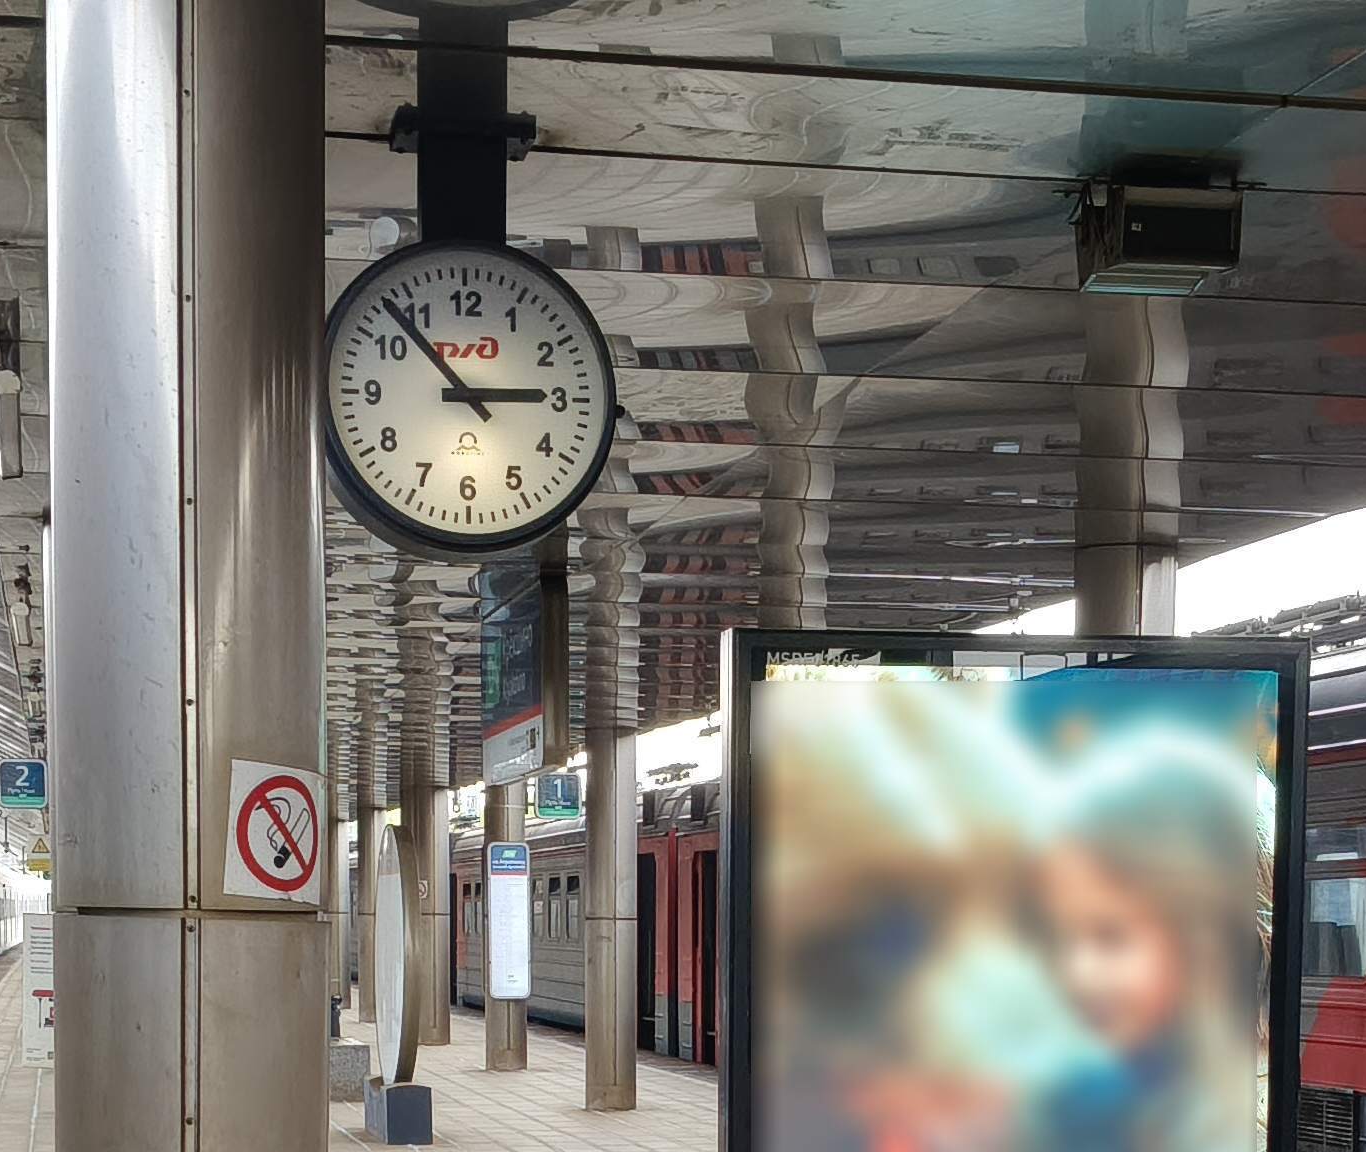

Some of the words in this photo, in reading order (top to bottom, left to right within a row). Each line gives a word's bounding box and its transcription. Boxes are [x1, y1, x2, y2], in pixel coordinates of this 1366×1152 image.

[404, 302, 431, 329] 11
[449, 291, 482, 317] 12
[505, 306, 517, 332] 1
[375, 335, 408, 361] 10
[537, 341, 554, 367] 2
[364, 380, 381, 405] 9
[551, 388, 567, 412] 3
[380, 427, 397, 452] 8
[536, 432, 553, 457] 4
[415, 462, 433, 487] 7
[505, 465, 522, 490] 5
[459, 476, 476, 501] 6
[15, 765, 30, 787] 2
[553, 778, 562, 799] 1
